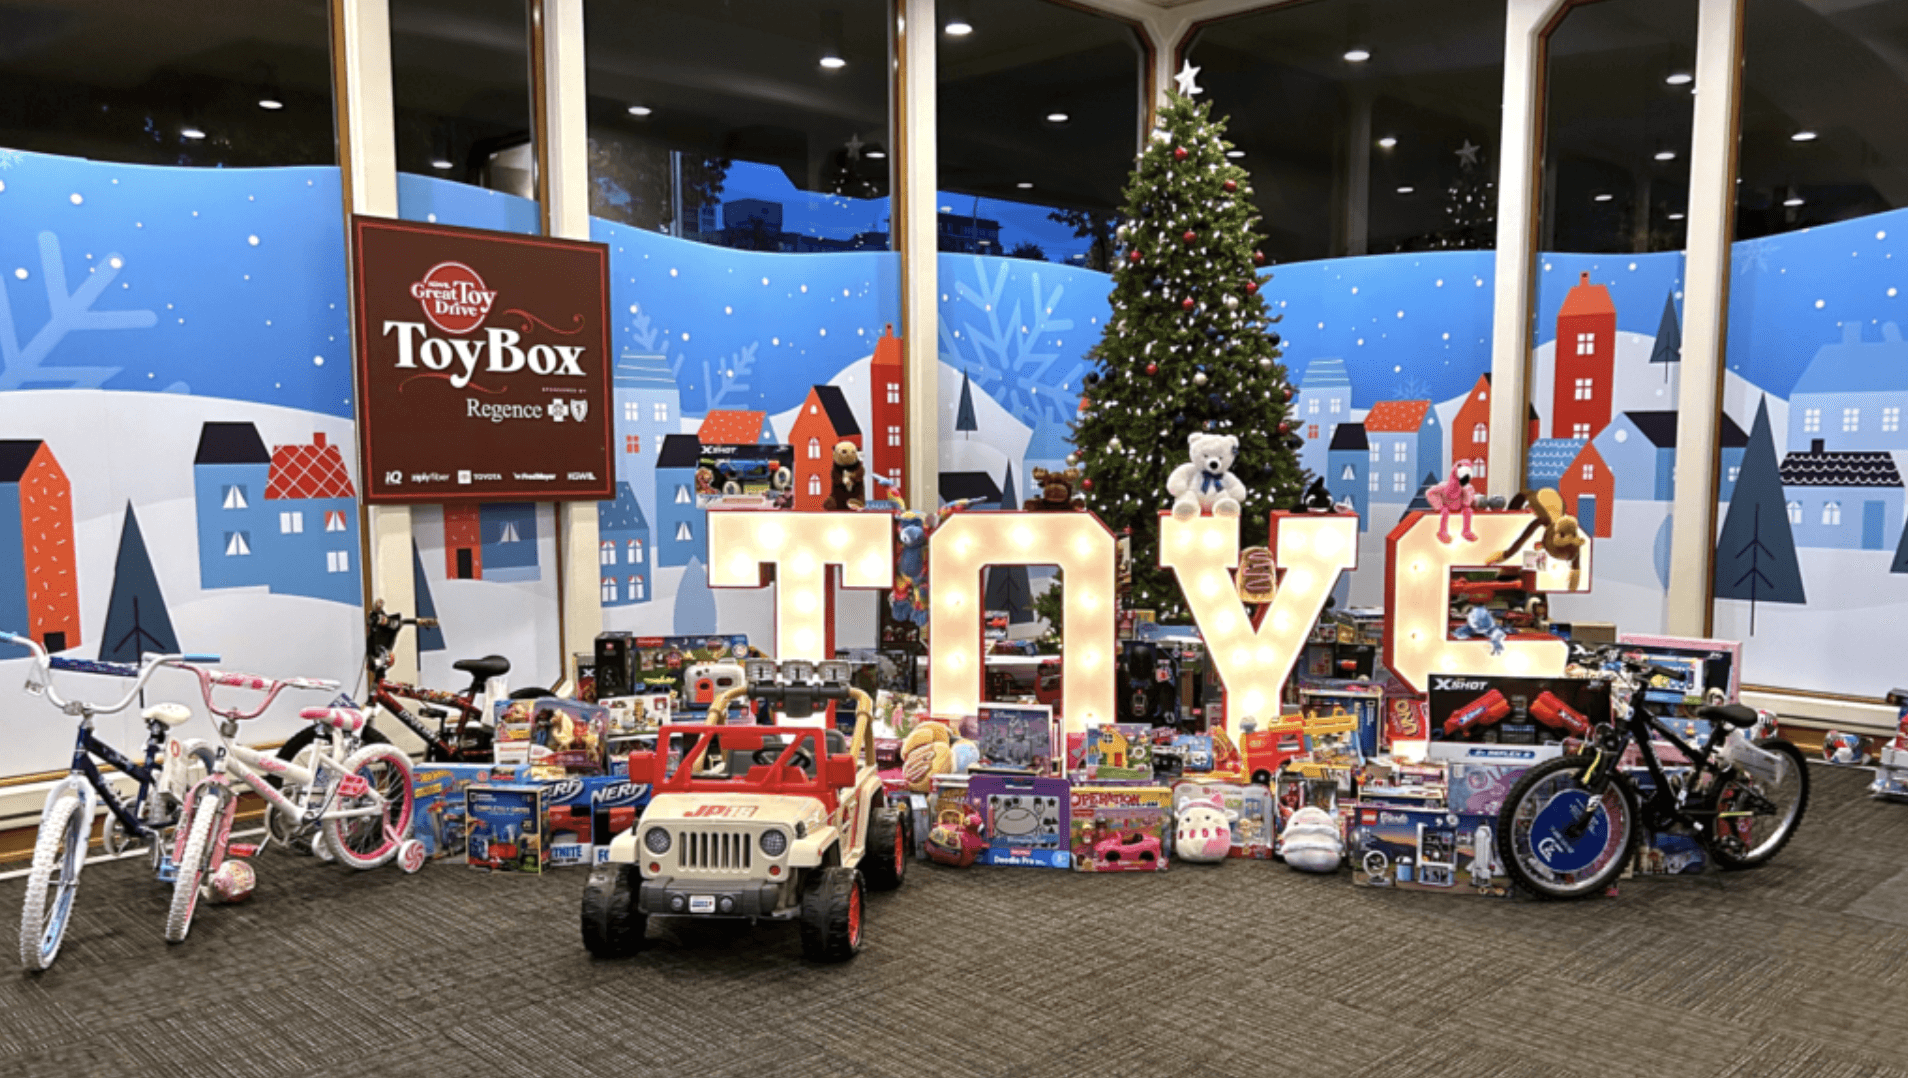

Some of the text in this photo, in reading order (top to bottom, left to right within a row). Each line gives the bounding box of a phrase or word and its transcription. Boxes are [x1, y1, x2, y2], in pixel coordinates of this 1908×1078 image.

[411, 280, 496, 313] Great Toy
[435, 300, 478, 317] Drive
[382, 320, 587, 388] ToyBox
[466, 398, 543, 423] Regence
[473, 473, 502, 481] TOYOTA
[1433, 678, 1488, 691] XSHOT
[1394, 699, 1418, 736] UNO
[592, 782, 648, 803] NERF
[1071, 792, 1140, 806] OPERATION
[994, 855, 1020, 865] Doodle
[1022, 856, 1035, 865] Pro
